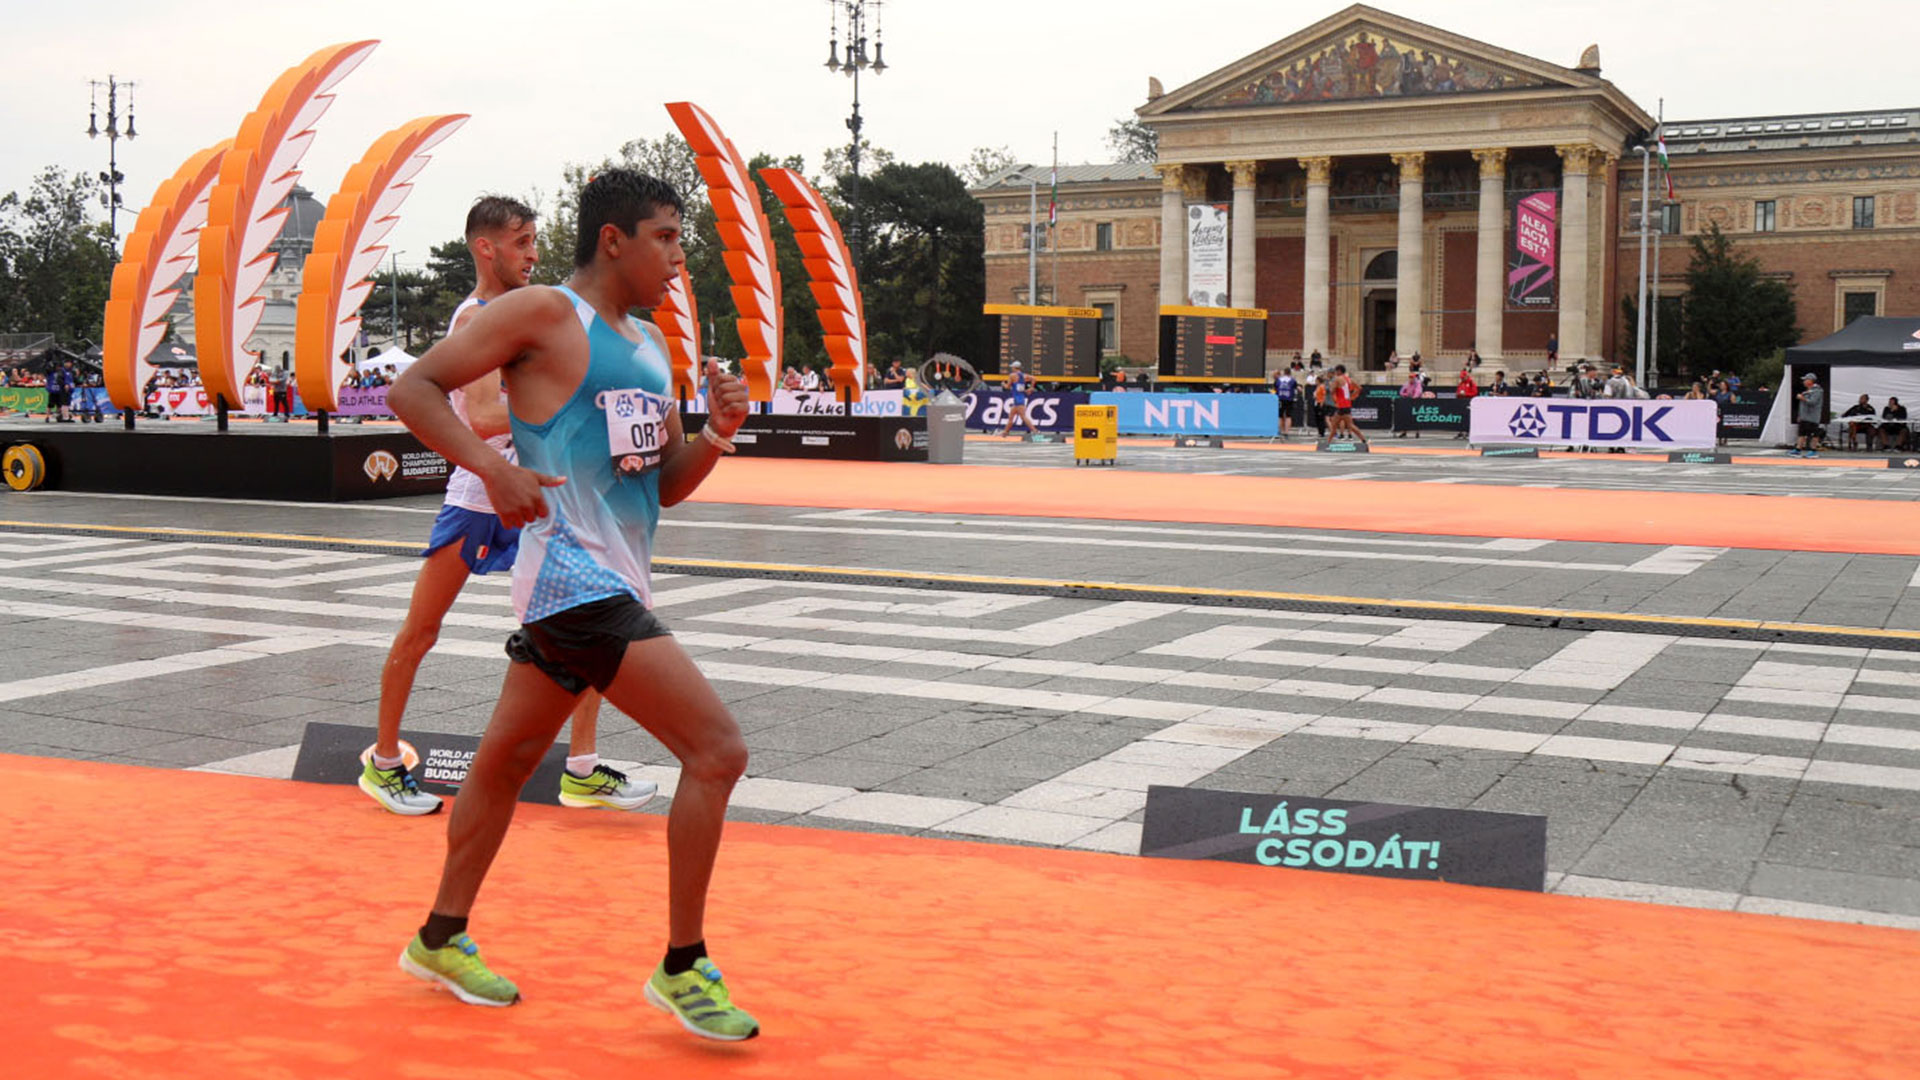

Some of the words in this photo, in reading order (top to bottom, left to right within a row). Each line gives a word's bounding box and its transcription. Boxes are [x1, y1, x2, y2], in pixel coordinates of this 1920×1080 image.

[1521, 213, 1548, 235] ALEA
[1521, 224, 1551, 249] IACTA
[1520, 236, 1547, 257] EST?
[1144, 398, 1220, 430] NTN
[1547, 404, 1675, 442] TDK
[402, 467, 439, 476] BUDAPEST
[430, 748, 462, 759] WORLD
[1239, 801, 1349, 836] LÁSS
[1255, 833, 1441, 870] CSODÁT!
